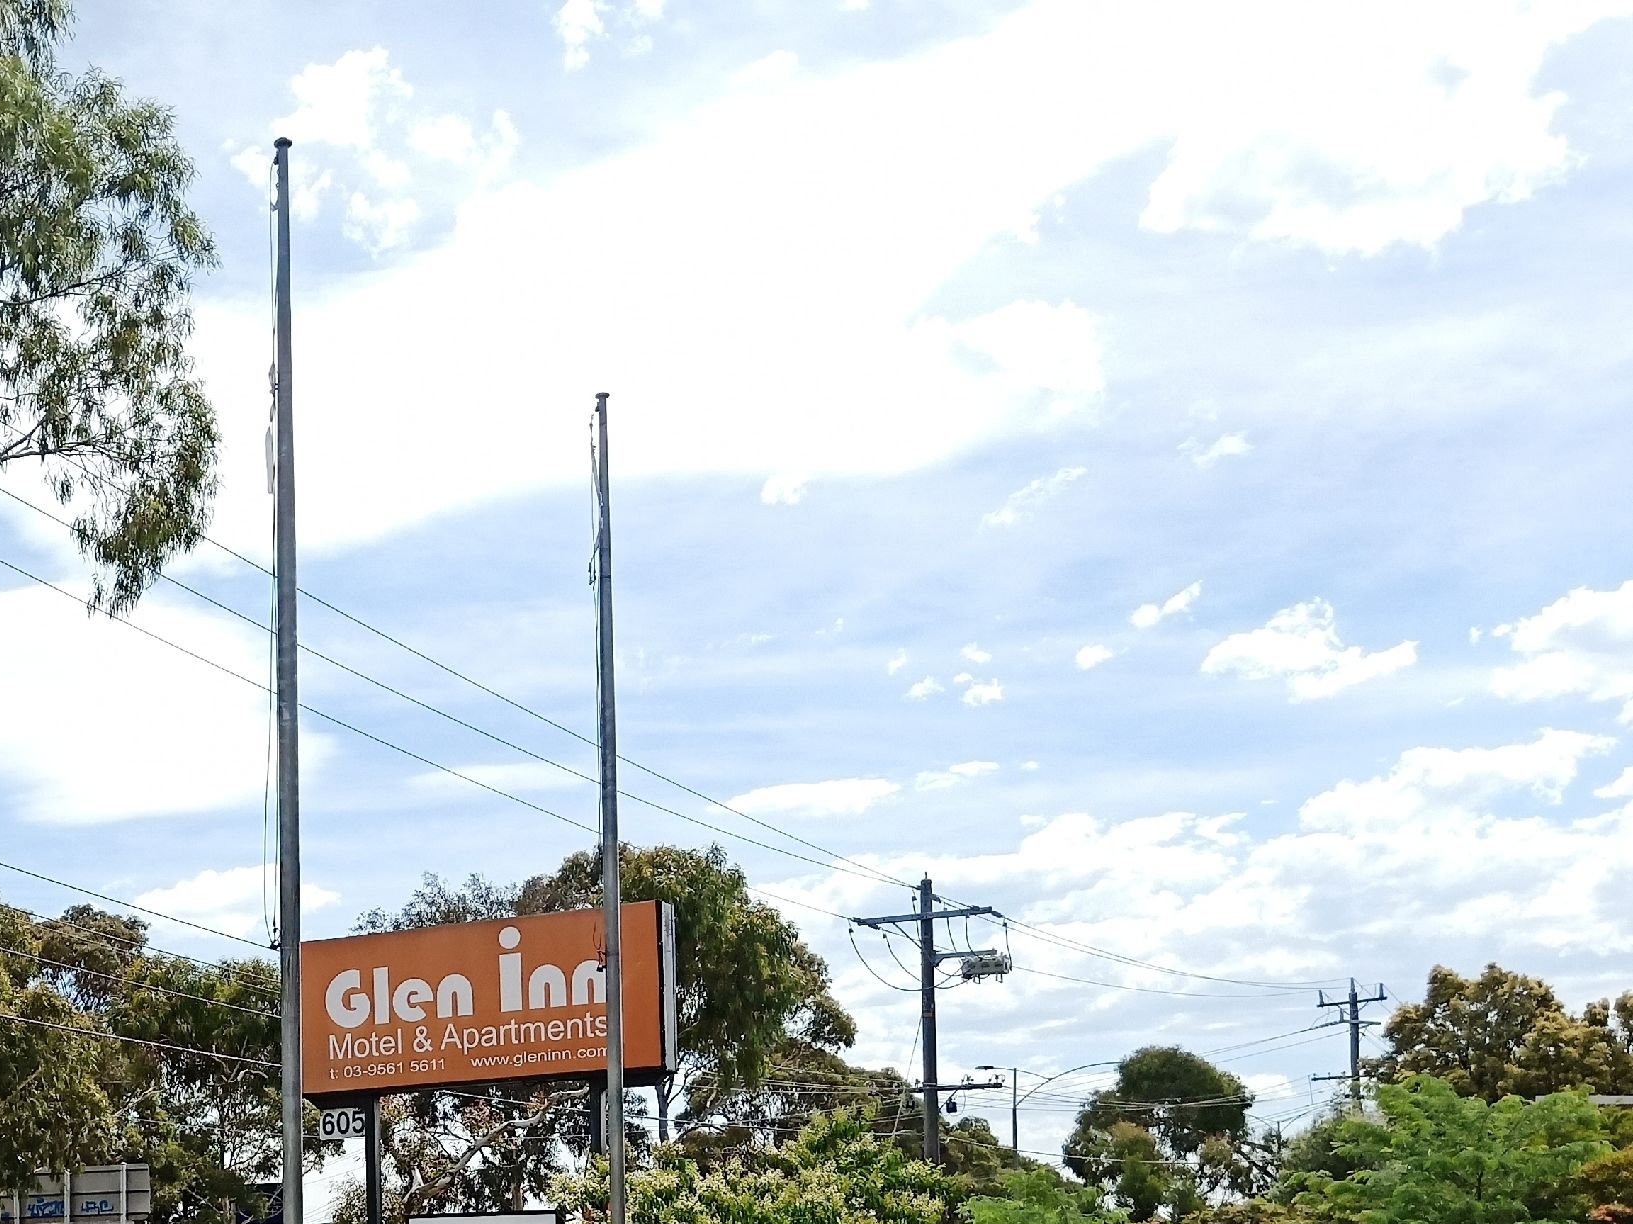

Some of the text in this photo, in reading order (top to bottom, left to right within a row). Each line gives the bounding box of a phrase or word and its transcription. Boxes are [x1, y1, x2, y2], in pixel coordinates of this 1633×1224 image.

[325, 925, 607, 1029] Glen inn
[328, 1012, 608, 1061] Motel & Apartments
[329, 1045, 608, 1080] t: 03-9561 5611 www.gleninn.com
[322, 1110, 366, 1136] 605
